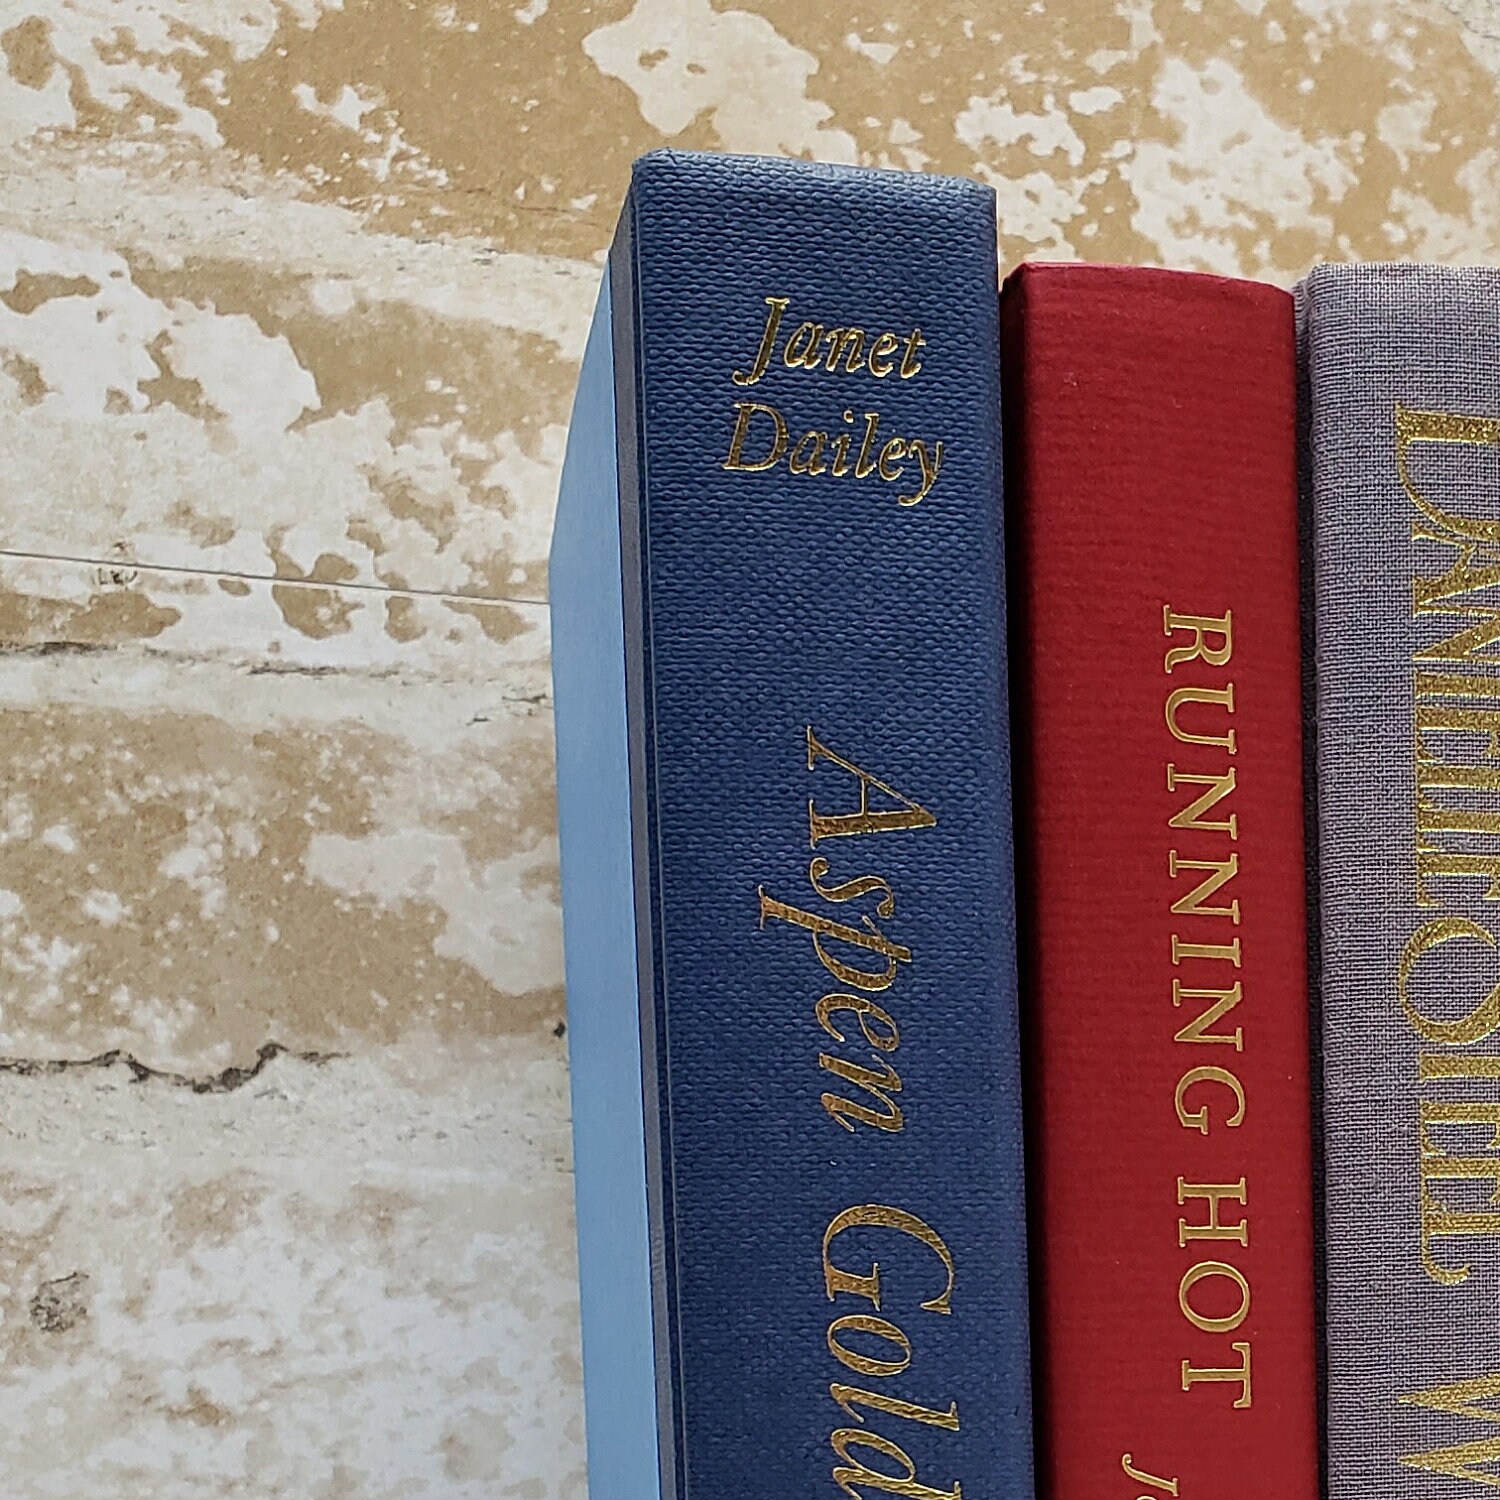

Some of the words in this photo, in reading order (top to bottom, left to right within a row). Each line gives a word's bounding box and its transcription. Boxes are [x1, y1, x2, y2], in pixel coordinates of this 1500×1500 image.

[722, 402, 945, 508] Dailey
[733, 297, 926, 386] Janet
[758, 726, 938, 1133] Aspen
[1162, 604, 1246, 1136] RUNNING
[1175, 1176, 1252, 1409] HOT
